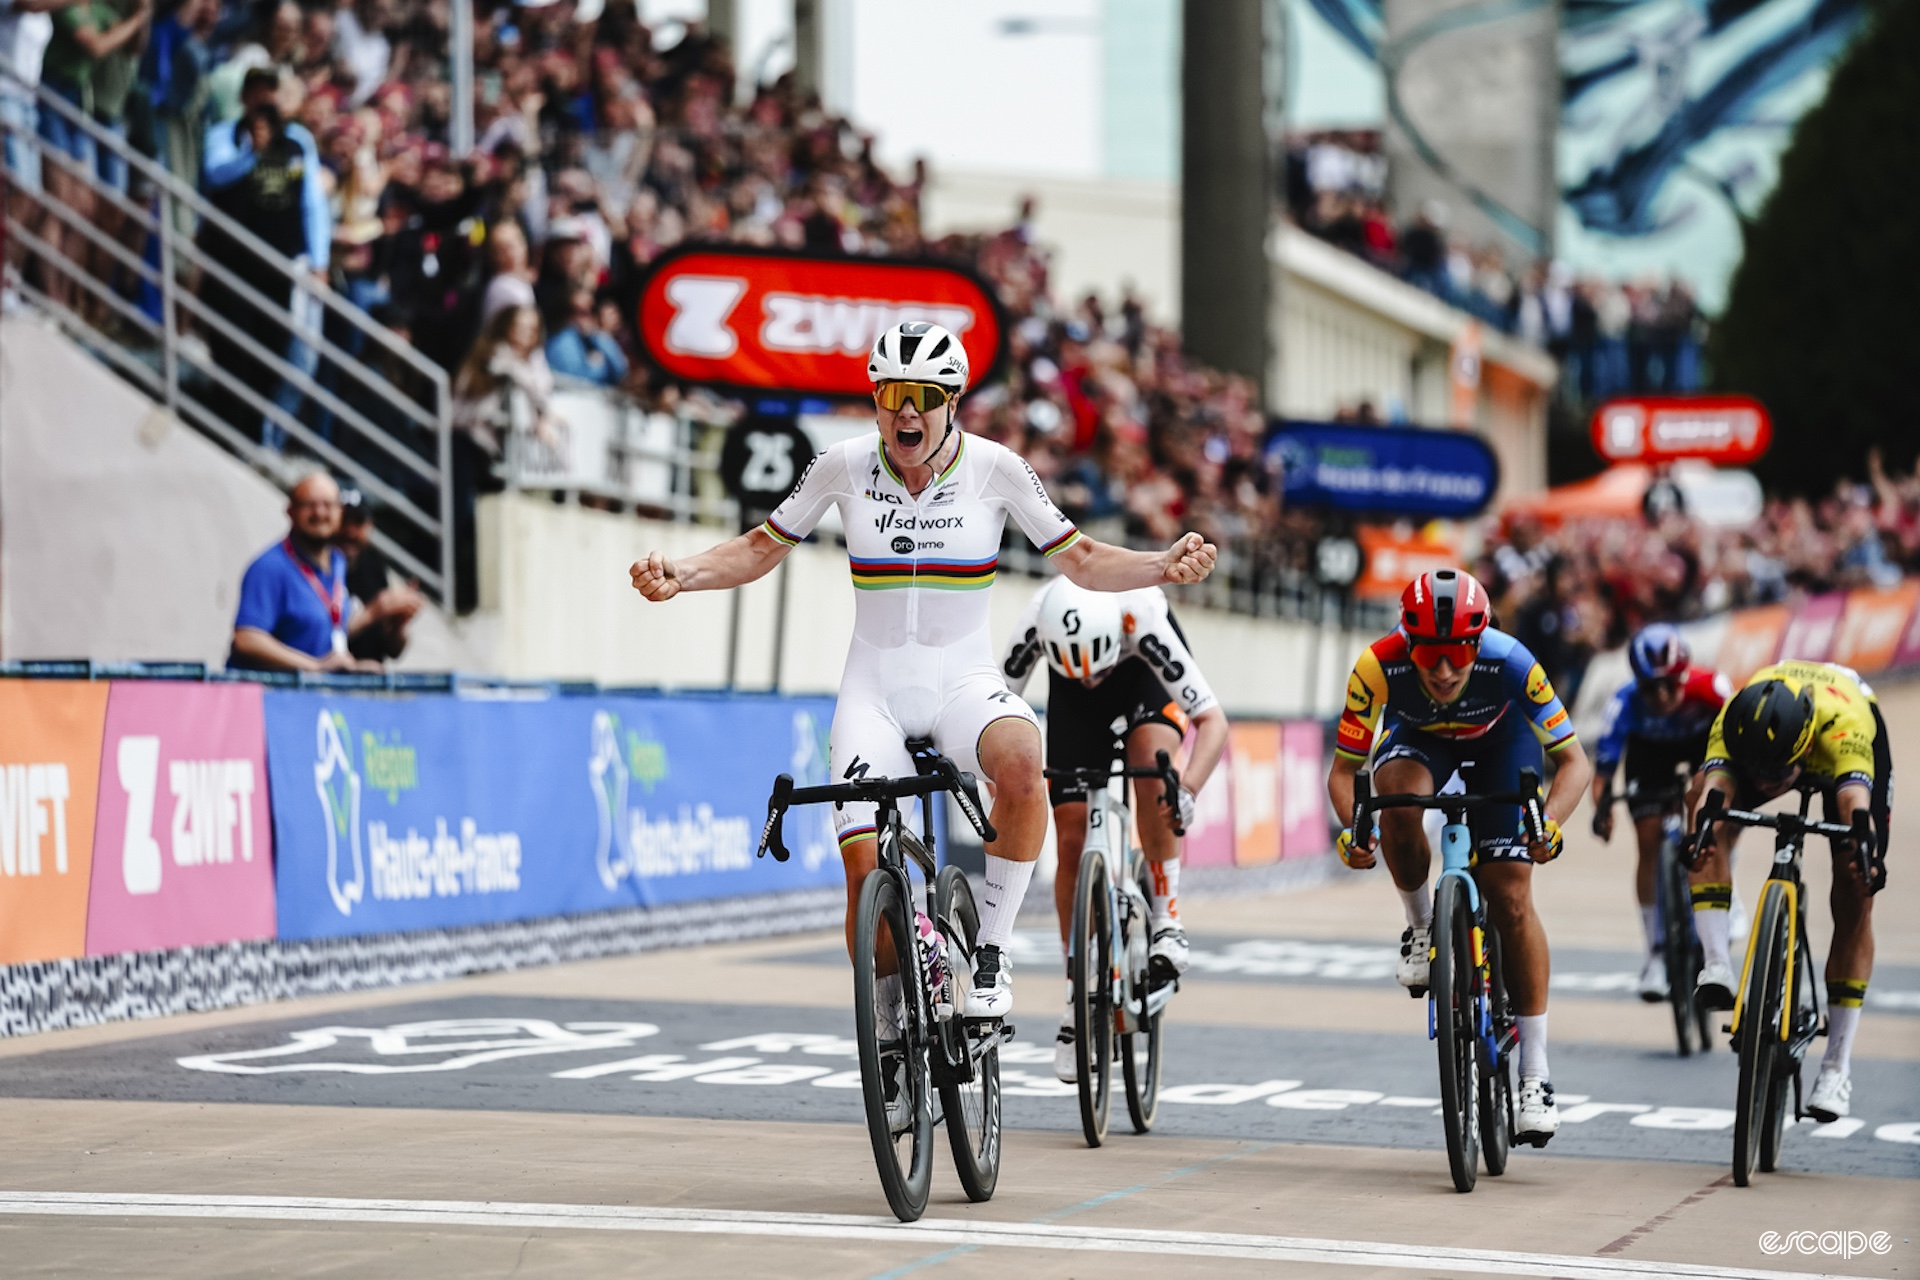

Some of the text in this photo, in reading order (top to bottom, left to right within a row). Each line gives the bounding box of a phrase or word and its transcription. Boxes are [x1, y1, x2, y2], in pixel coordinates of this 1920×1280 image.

[168, 758, 255, 867] ZWIFT
[955, 790, 984, 833] SRAM
[367, 815, 522, 901] Hauts-de-France
